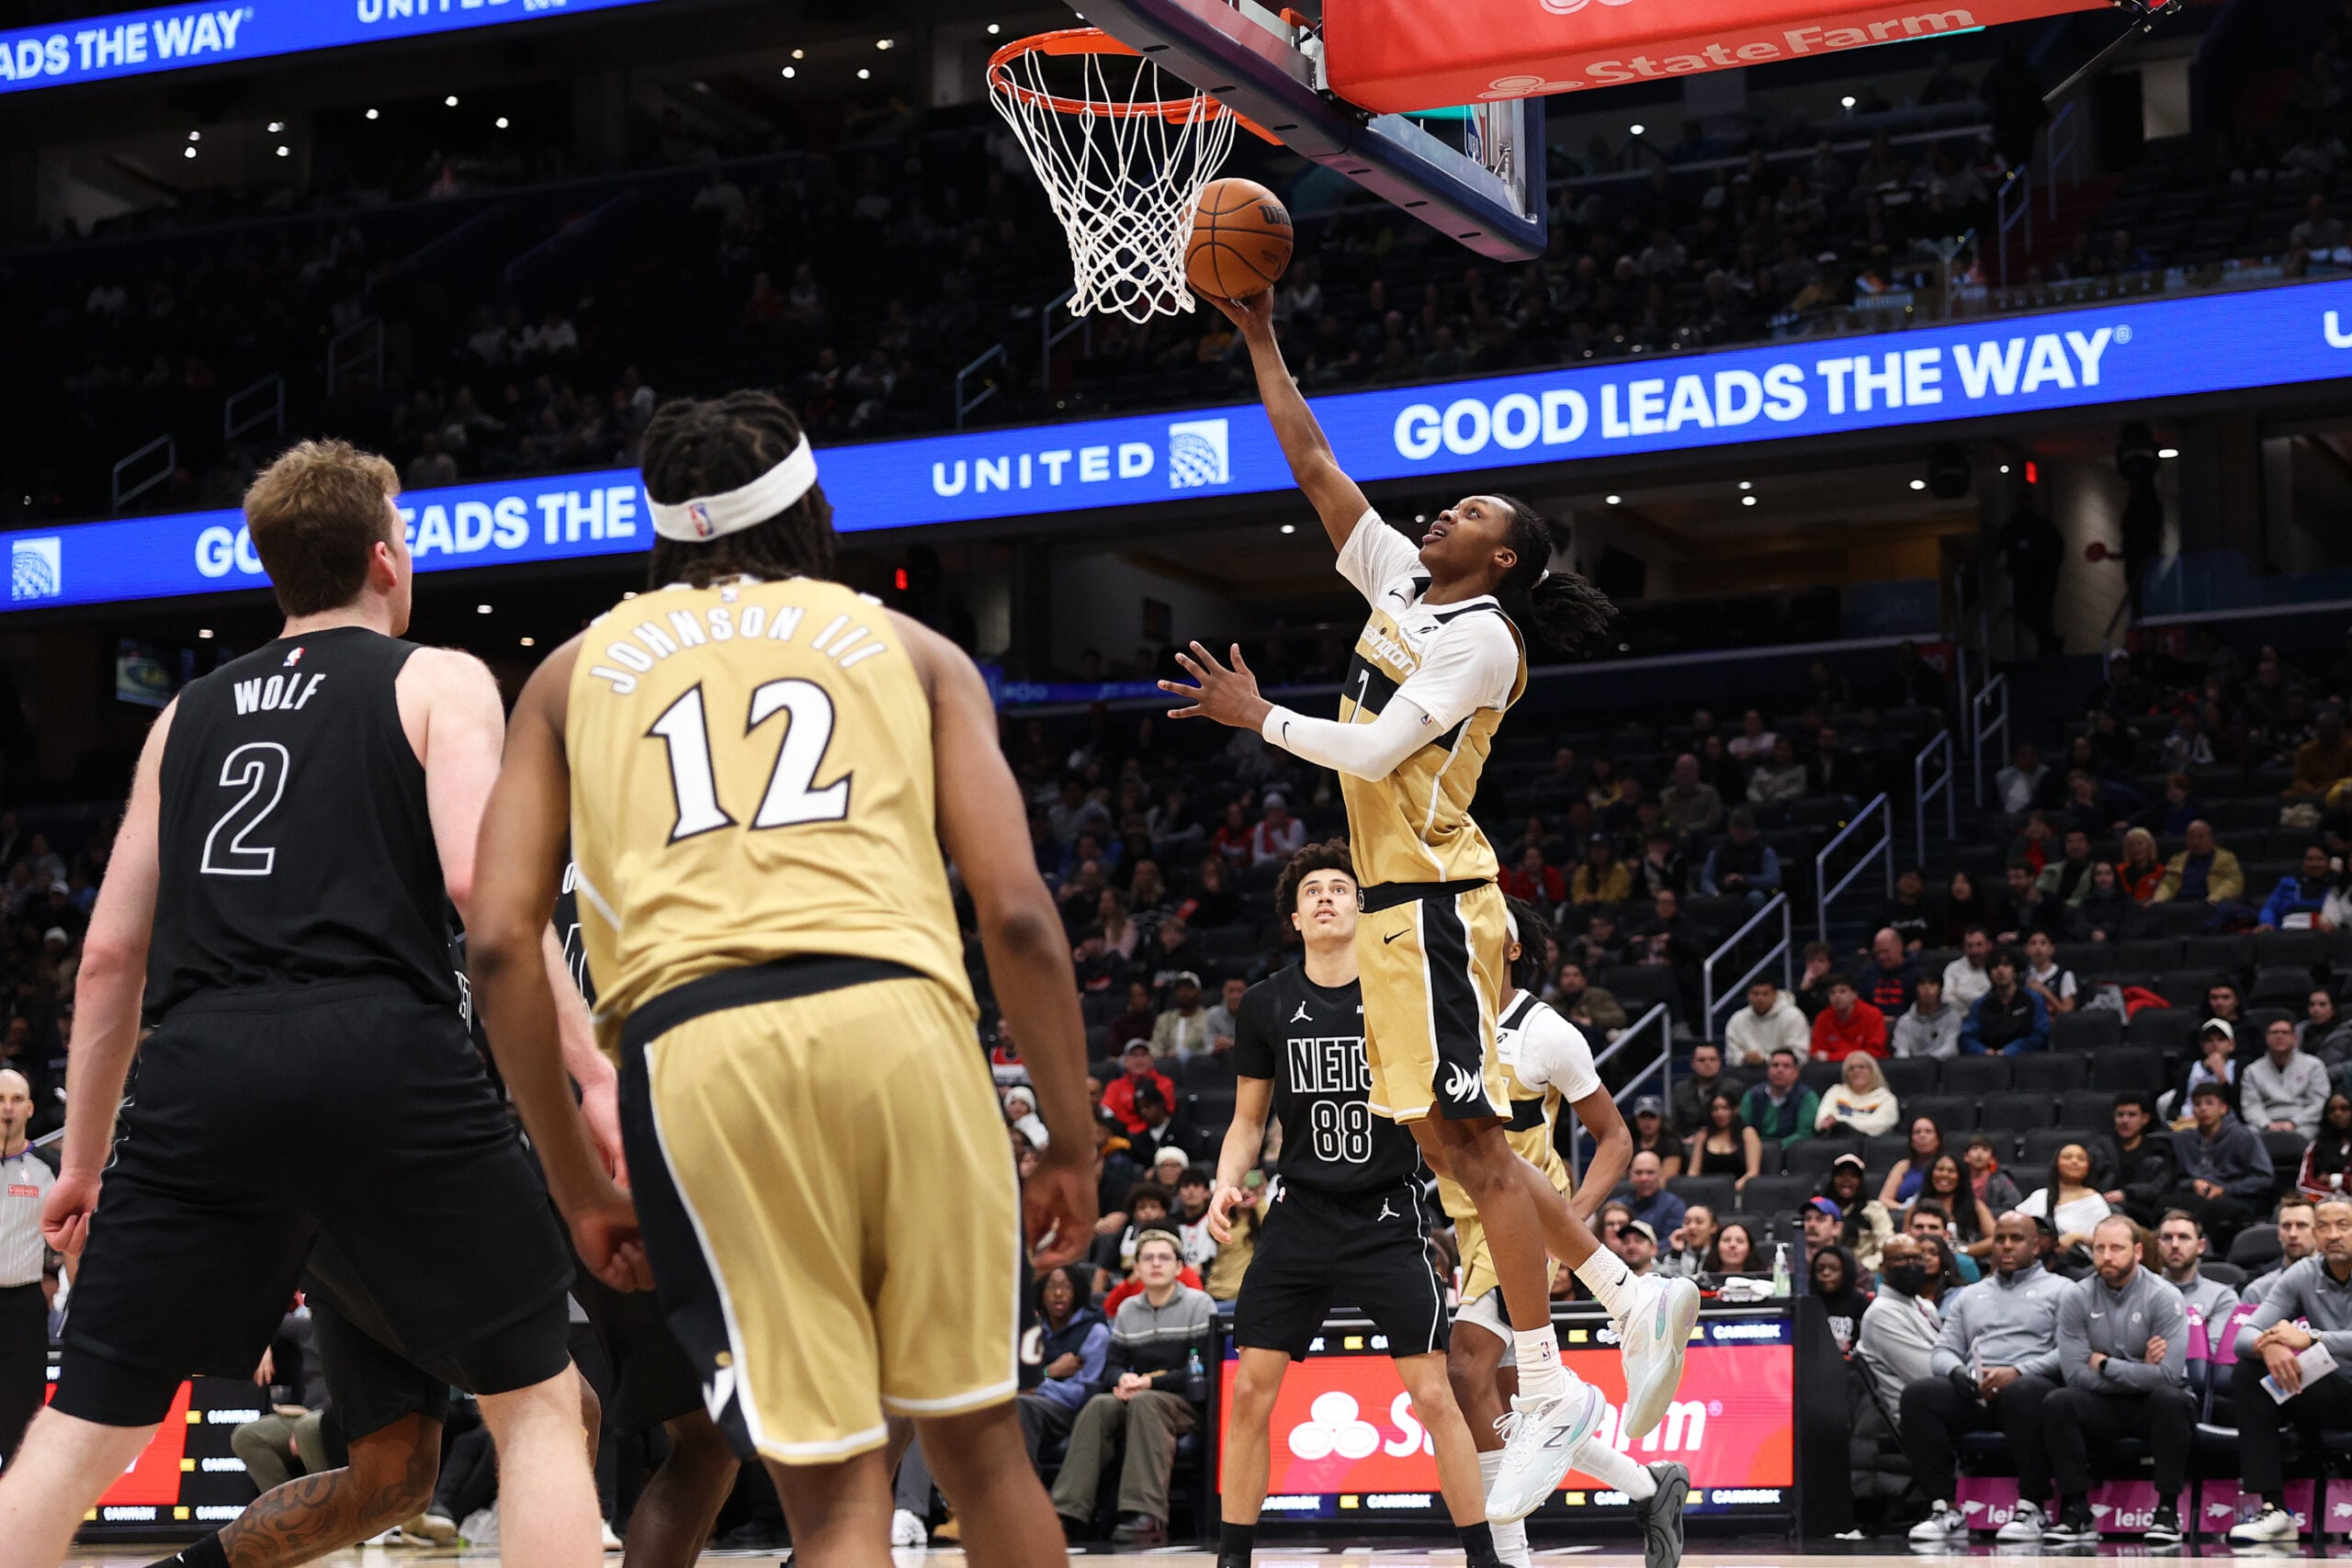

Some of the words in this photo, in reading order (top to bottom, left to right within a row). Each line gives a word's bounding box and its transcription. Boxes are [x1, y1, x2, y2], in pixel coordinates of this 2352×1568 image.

[74, 22, 148, 71] THE
[1585, 45, 1781, 85] State
[1782, 8, 1976, 53] Farm
[1393, 389, 1589, 460] GOOD
[1600, 363, 1808, 439] LEADS
[1816, 347, 1943, 414] THE
[932, 442, 1155, 497] UNITED
[536, 486, 636, 544] THE
[590, 604, 806, 696] JOHNSON
[810, 614, 888, 669] III
[233, 672, 327, 716] WOLF
[642, 676, 855, 849] 12
[199, 741, 290, 875] 2
[1311, 1100, 1373, 1164] 88
